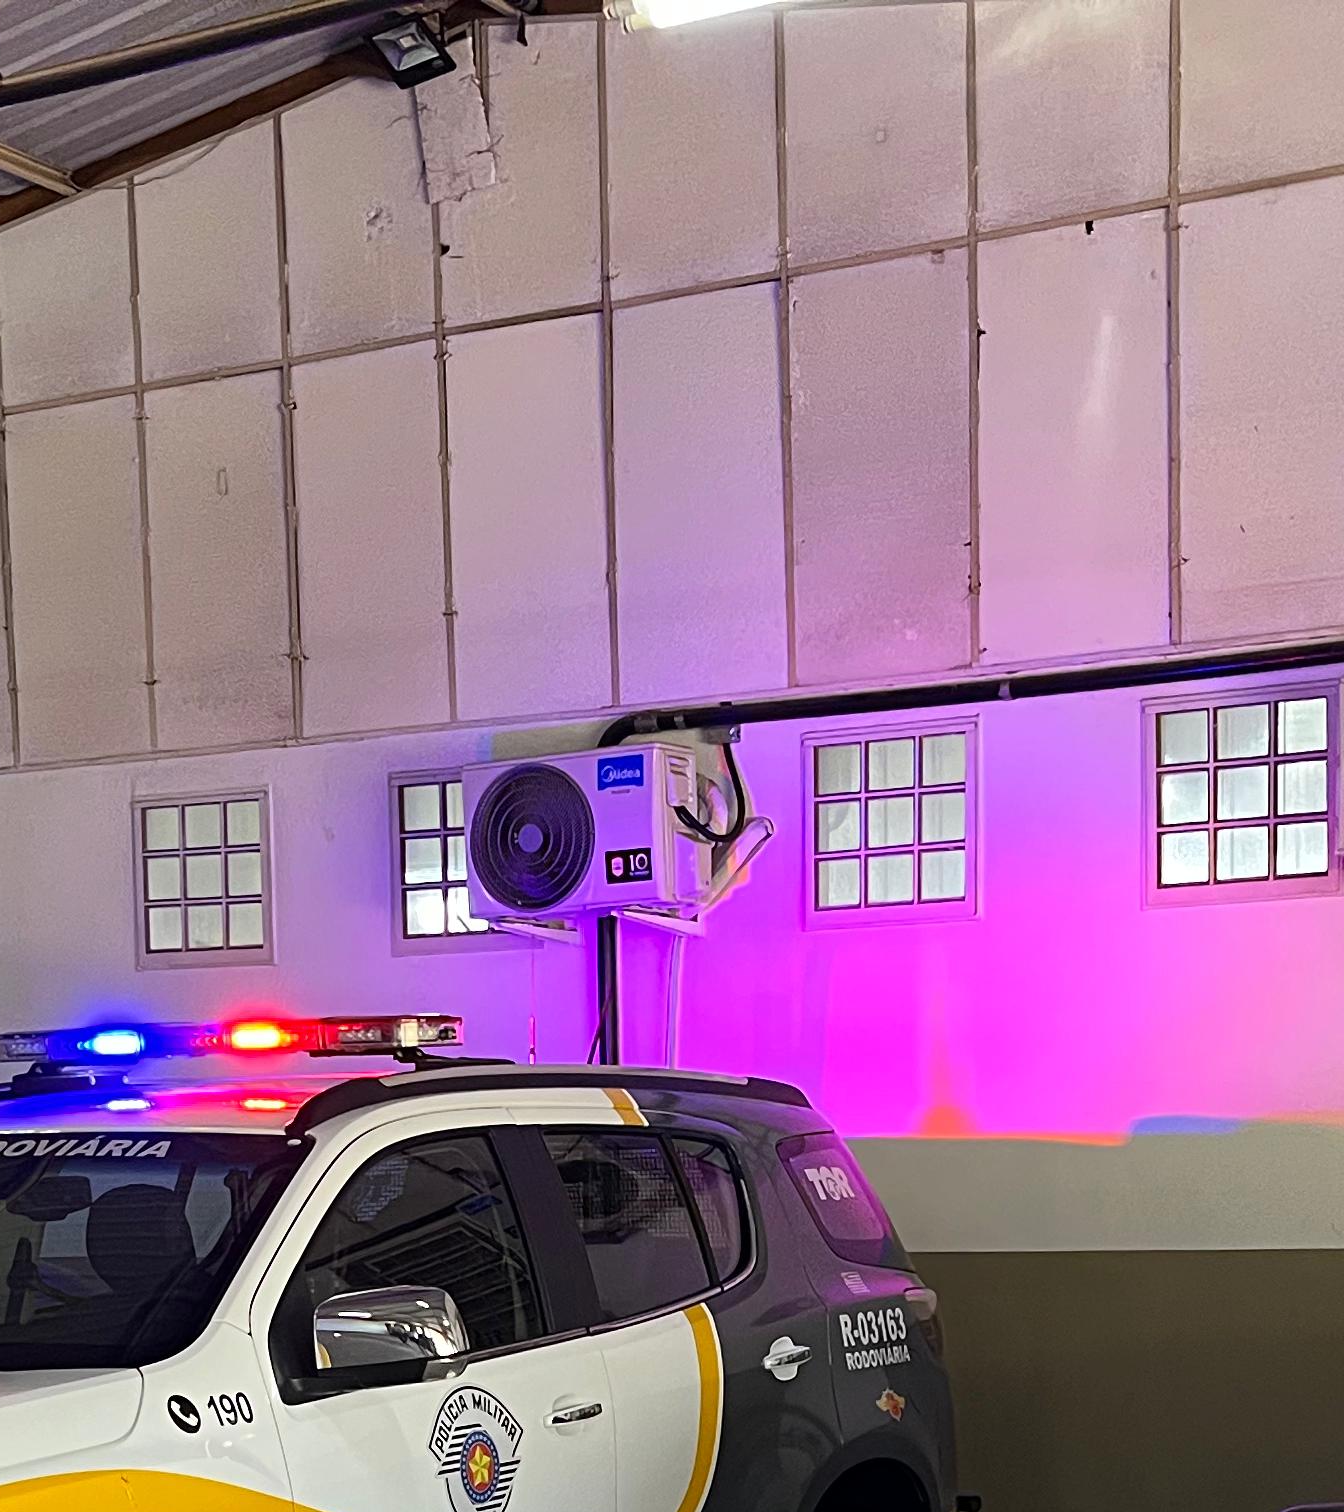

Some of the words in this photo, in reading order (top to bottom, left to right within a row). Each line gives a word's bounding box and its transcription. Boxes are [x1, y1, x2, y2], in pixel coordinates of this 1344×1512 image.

[839, 1307, 907, 1348] R-03163
[845, 1343, 910, 1371] RODOVIÁRIA
[207, 1392, 254, 1426] 190
[434, 1394, 469, 1454] POLÍCIA
[471, 1392, 517, 1442] MILITAR
